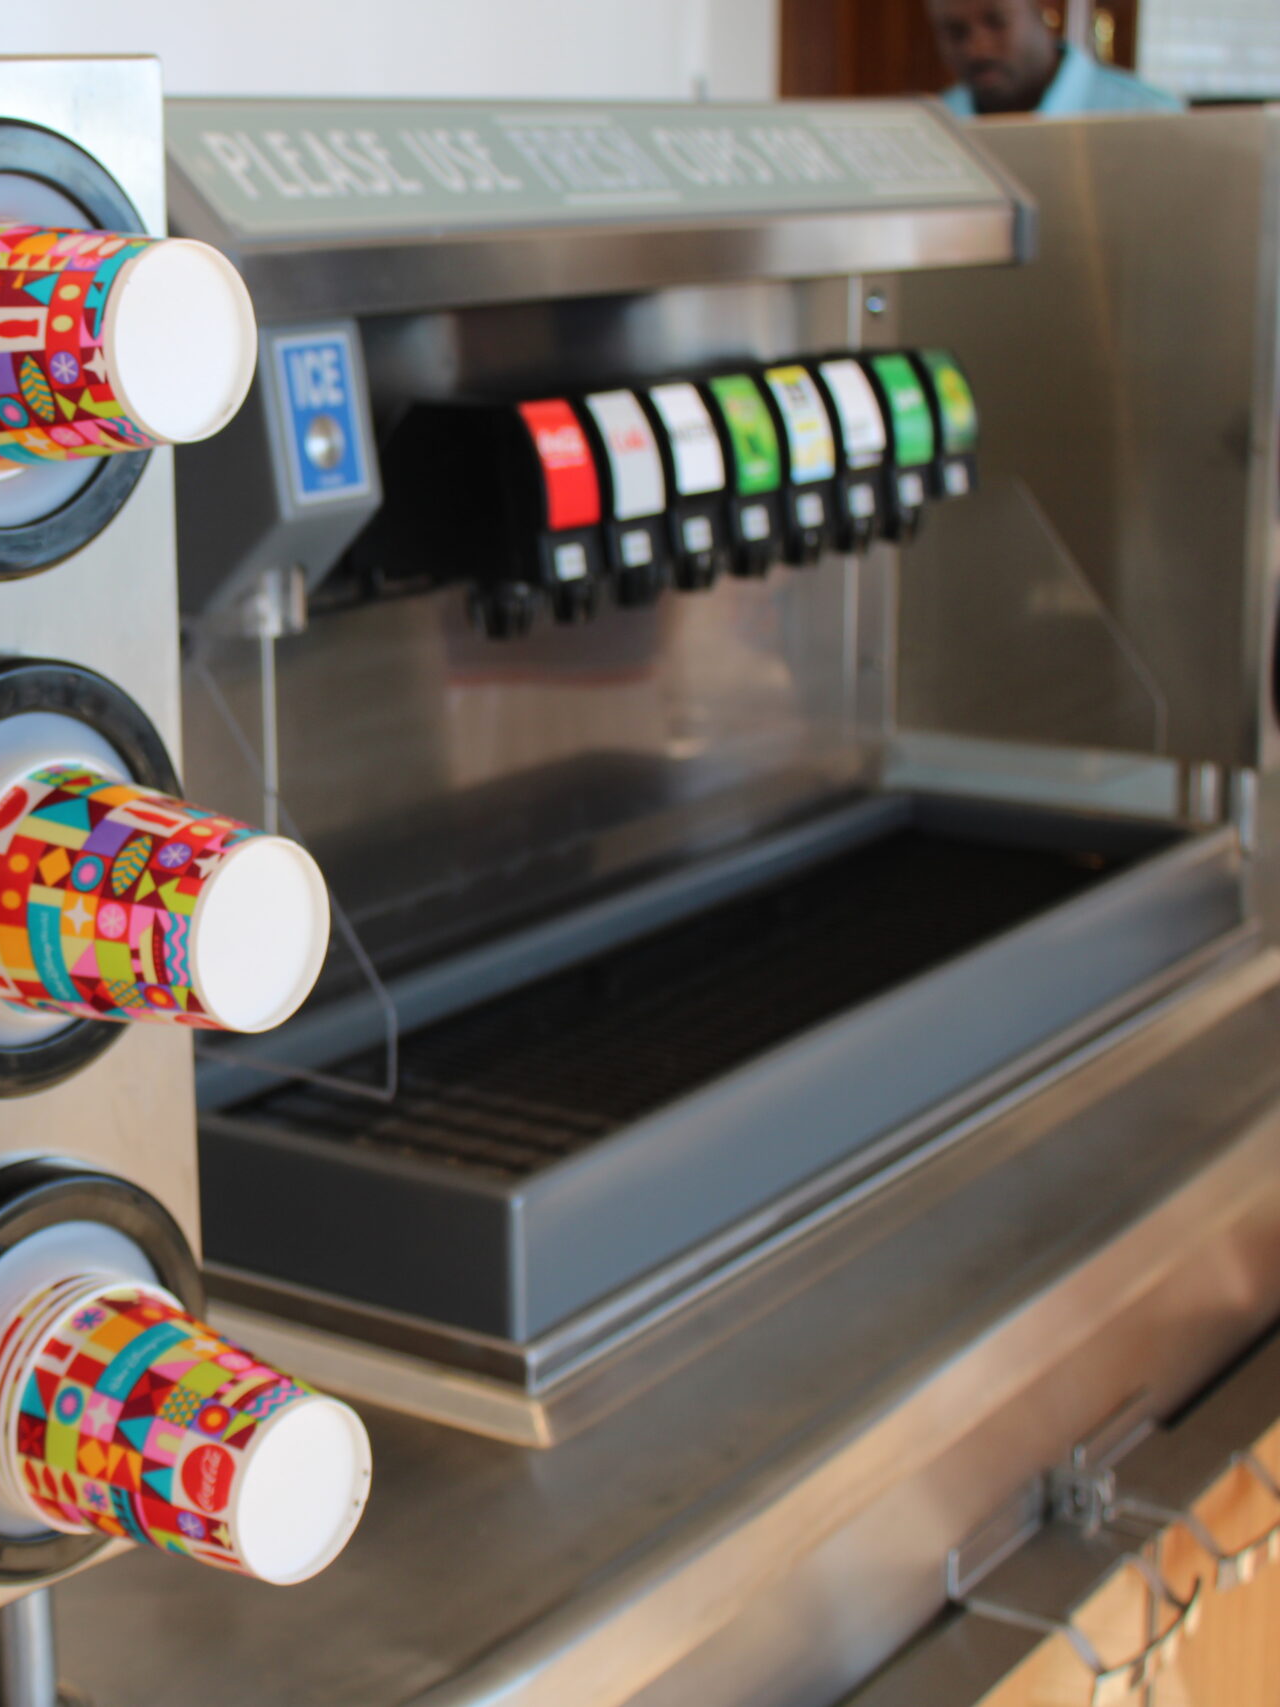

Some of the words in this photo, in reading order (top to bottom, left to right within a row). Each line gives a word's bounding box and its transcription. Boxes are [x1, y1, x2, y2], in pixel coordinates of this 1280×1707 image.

[200, 129, 423, 199] PLEASE
[397, 128, 523, 194] USE
[289, 347, 345, 412] ICE
